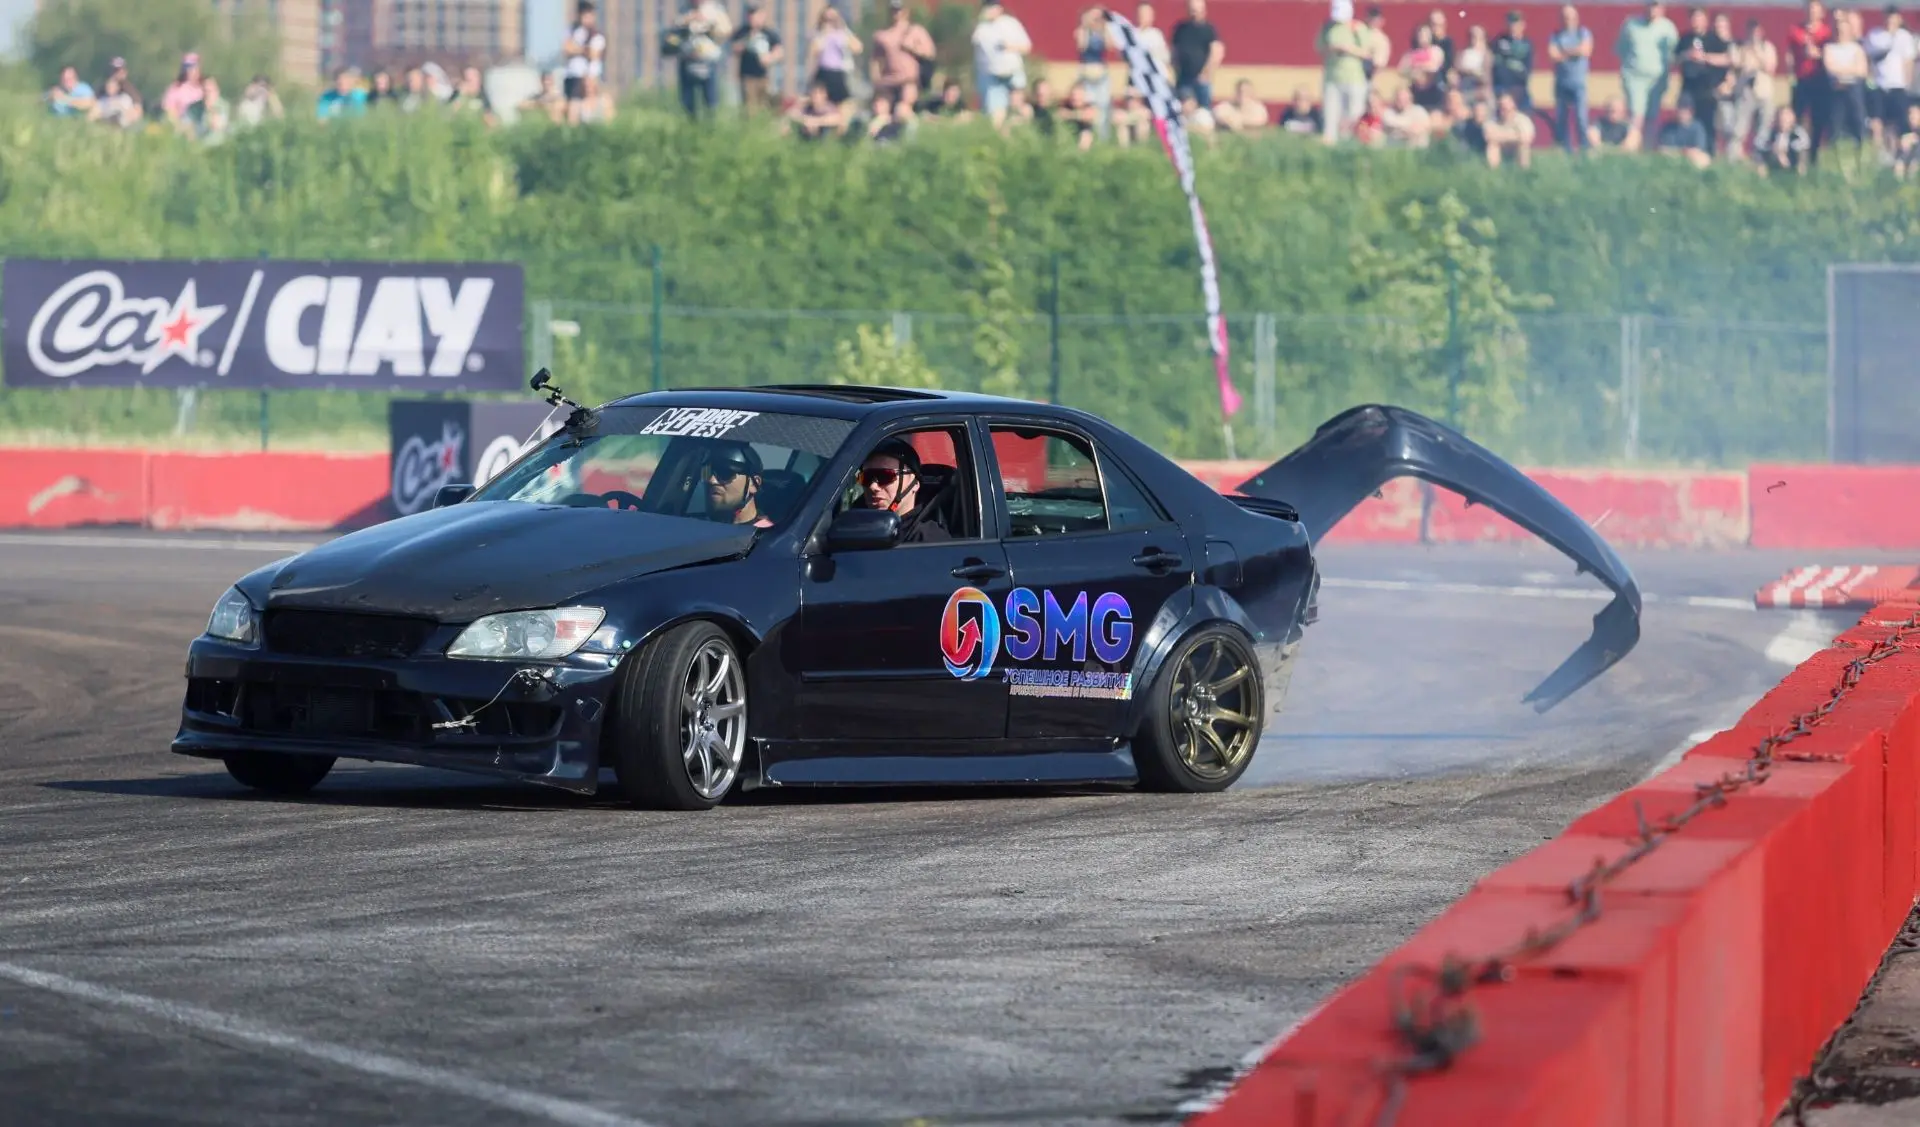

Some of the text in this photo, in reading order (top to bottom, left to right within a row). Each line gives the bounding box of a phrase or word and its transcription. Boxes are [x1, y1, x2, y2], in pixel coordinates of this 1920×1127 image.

[700, 408, 760, 426] DRIFT
[686, 422, 735, 439] FEST
[1004, 587, 1134, 664] SMG
[1002, 668, 1132, 689] УСПЕШНОЕ РАЗВИТИЕ
